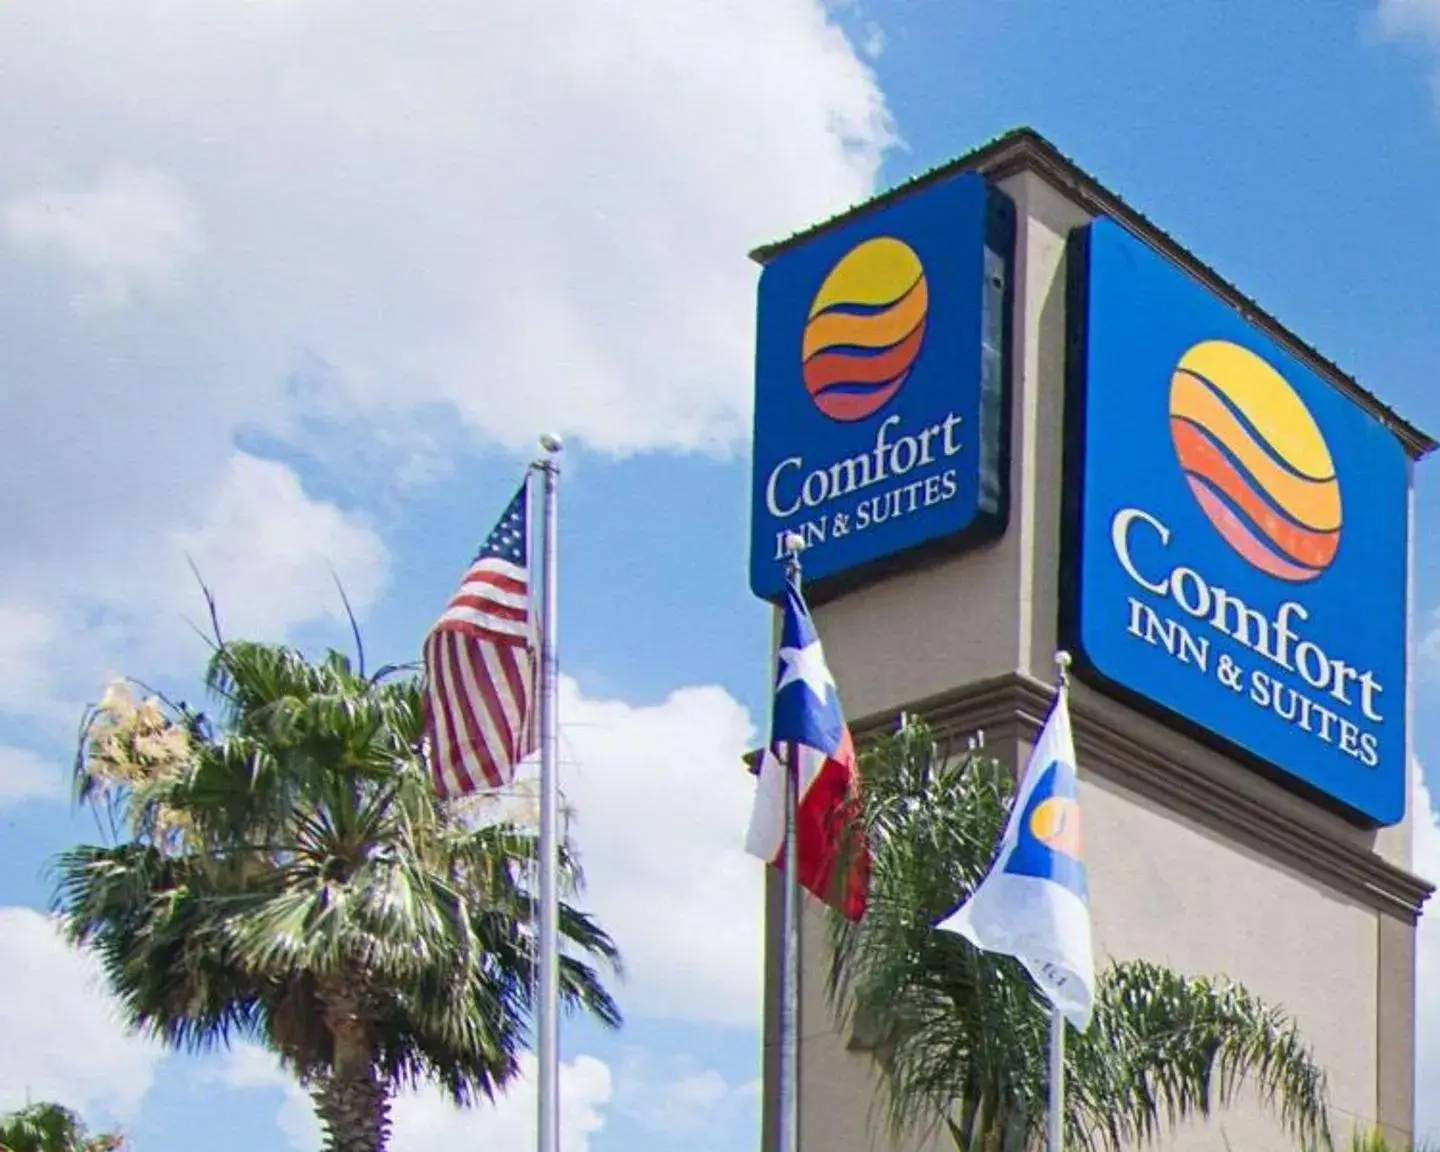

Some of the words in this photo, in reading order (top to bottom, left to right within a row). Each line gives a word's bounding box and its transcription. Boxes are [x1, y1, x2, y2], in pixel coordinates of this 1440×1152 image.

[766, 412, 962, 517] Comfort
[832, 512, 850, 539] &
[856, 469, 957, 531] SUITES
[1112, 508, 1384, 722] Comfort
[1127, 597, 1211, 672] INN
[1217, 654, 1243, 692] &
[1250, 669, 1379, 767] SUITES
